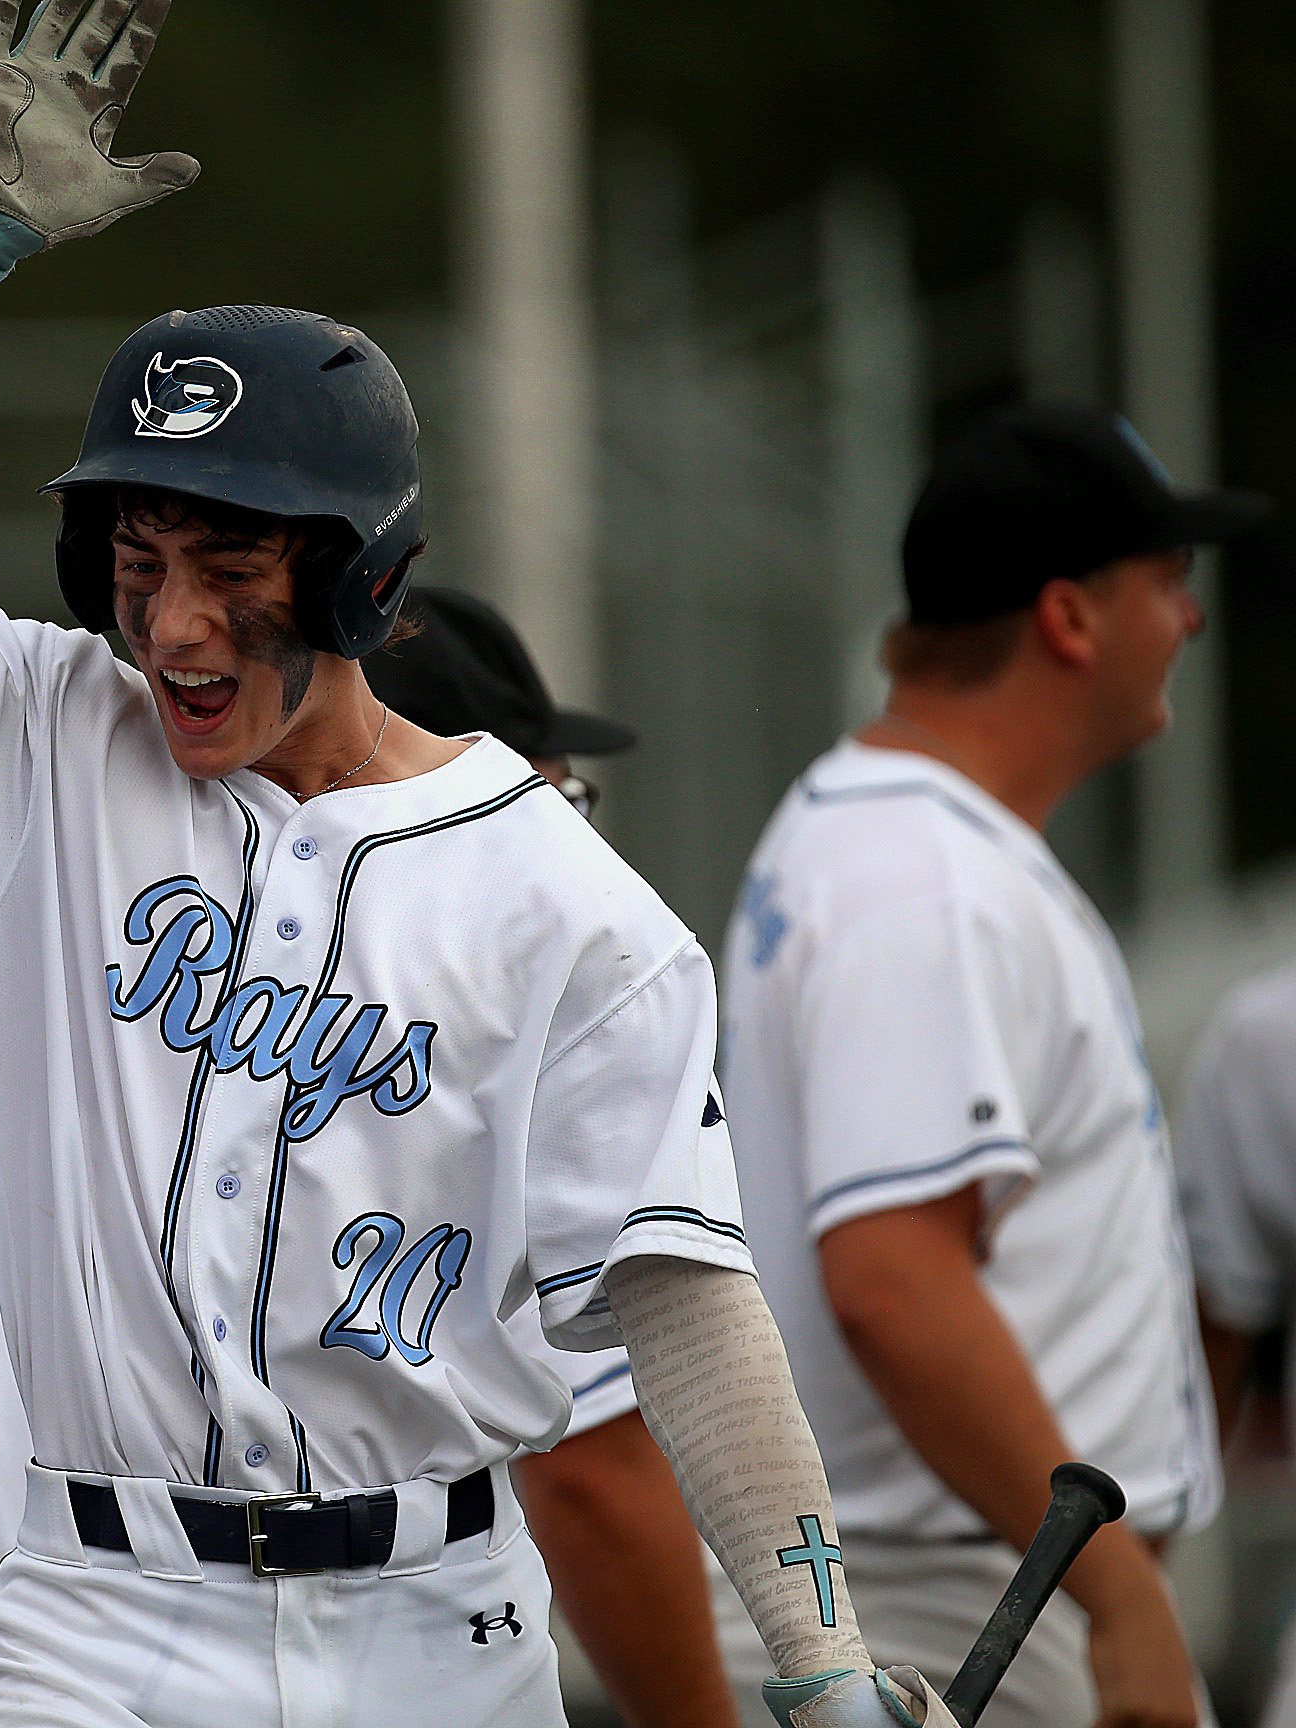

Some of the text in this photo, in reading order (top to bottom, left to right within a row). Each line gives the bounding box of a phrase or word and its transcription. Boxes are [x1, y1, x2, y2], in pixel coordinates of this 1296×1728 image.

[106, 874, 438, 1142] Rays
[319, 1211, 473, 1367] 20
[710, 1282, 734, 1297] WHO
[679, 1314, 699, 1329] ALL
[699, 1301, 740, 1320] THINGS
[687, 1343, 727, 1369] CHRIST
[752, 1332, 772, 1343] CAN
[725, 1355, 752, 1370] 4:13
[762, 1351, 783, 1363] WHO
[697, 1391, 712, 1407] DO
[714, 1380, 735, 1396] ALL
[735, 1374, 781, 1388] THINGS
[715, 1415, 759, 1437] CHRIST
[755, 1434, 785, 1449] 4:13
[715, 1469, 730, 1485] DO
[733, 1461, 754, 1476] ALL
[756, 1459, 801, 1473] THINGS
[739, 1503, 779, 1522] CHRIST
[741, 1553, 756, 1568] CAN
[759, 1550, 772, 1563] DO
[775, 1578, 809, 1595] CHRIST
[793, 1616, 810, 1627] ALL
